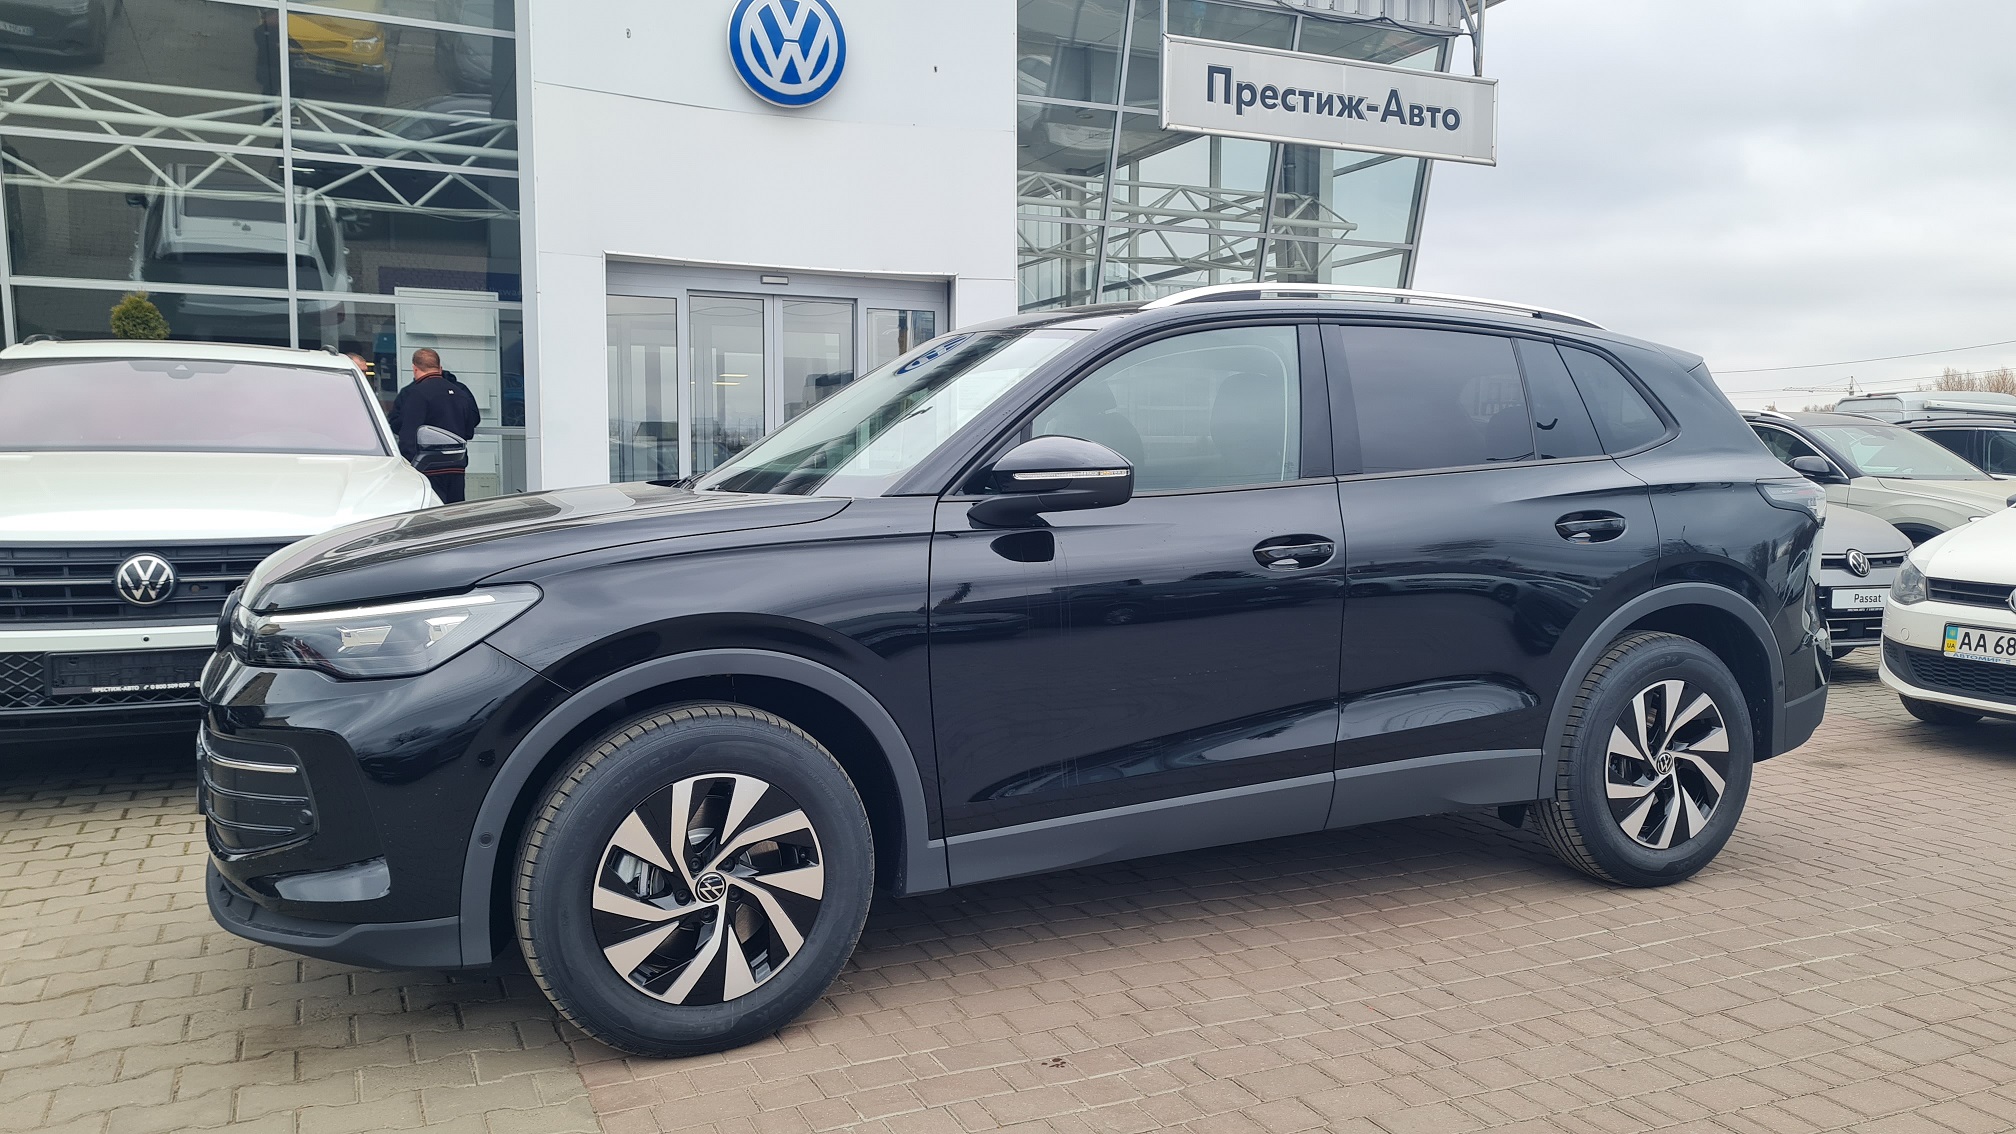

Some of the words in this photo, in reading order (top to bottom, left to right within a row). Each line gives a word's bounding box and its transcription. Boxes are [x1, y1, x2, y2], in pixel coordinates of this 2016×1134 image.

[738, 0, 839, 97] VW
[1207, 64, 1462, 131] Престиж-Авто
[119, 555, 173, 604] VW
[1853, 593, 1882, 604] Passat
[1959, 631, 1988, 653] AA
[1993, 635, 2016, 656] 68
